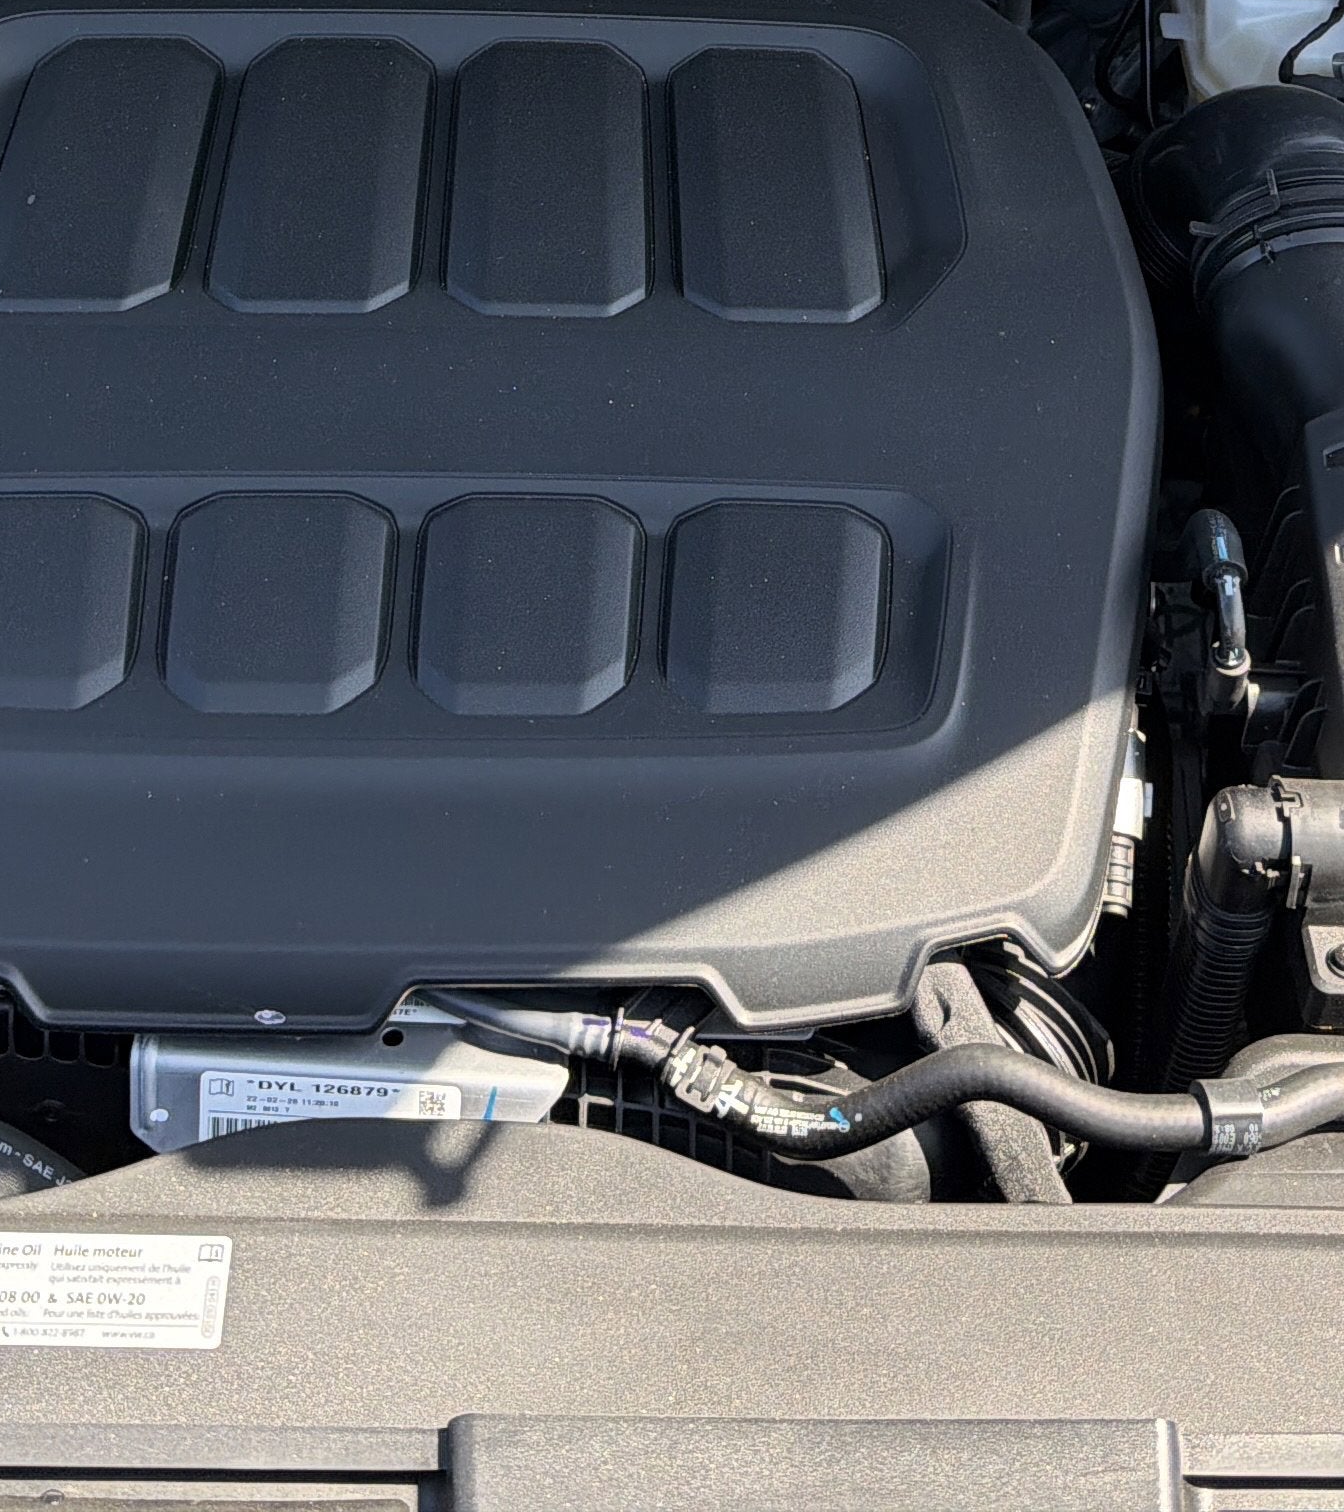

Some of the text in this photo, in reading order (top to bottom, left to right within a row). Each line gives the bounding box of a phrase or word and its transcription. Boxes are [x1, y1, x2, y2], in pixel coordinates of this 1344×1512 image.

[22, 1153, 56, 1180] SAE
[22, 1245, 42, 1256] Oil
[54, 1245, 89, 1257] Huile
[93, 1248, 143, 1258] moteur
[21, 1291, 40, 1303] 00
[48, 1293, 58, 1303] &
[67, 1292, 93, 1304] SAE
[97, 1292, 145, 1305] 0W-20
